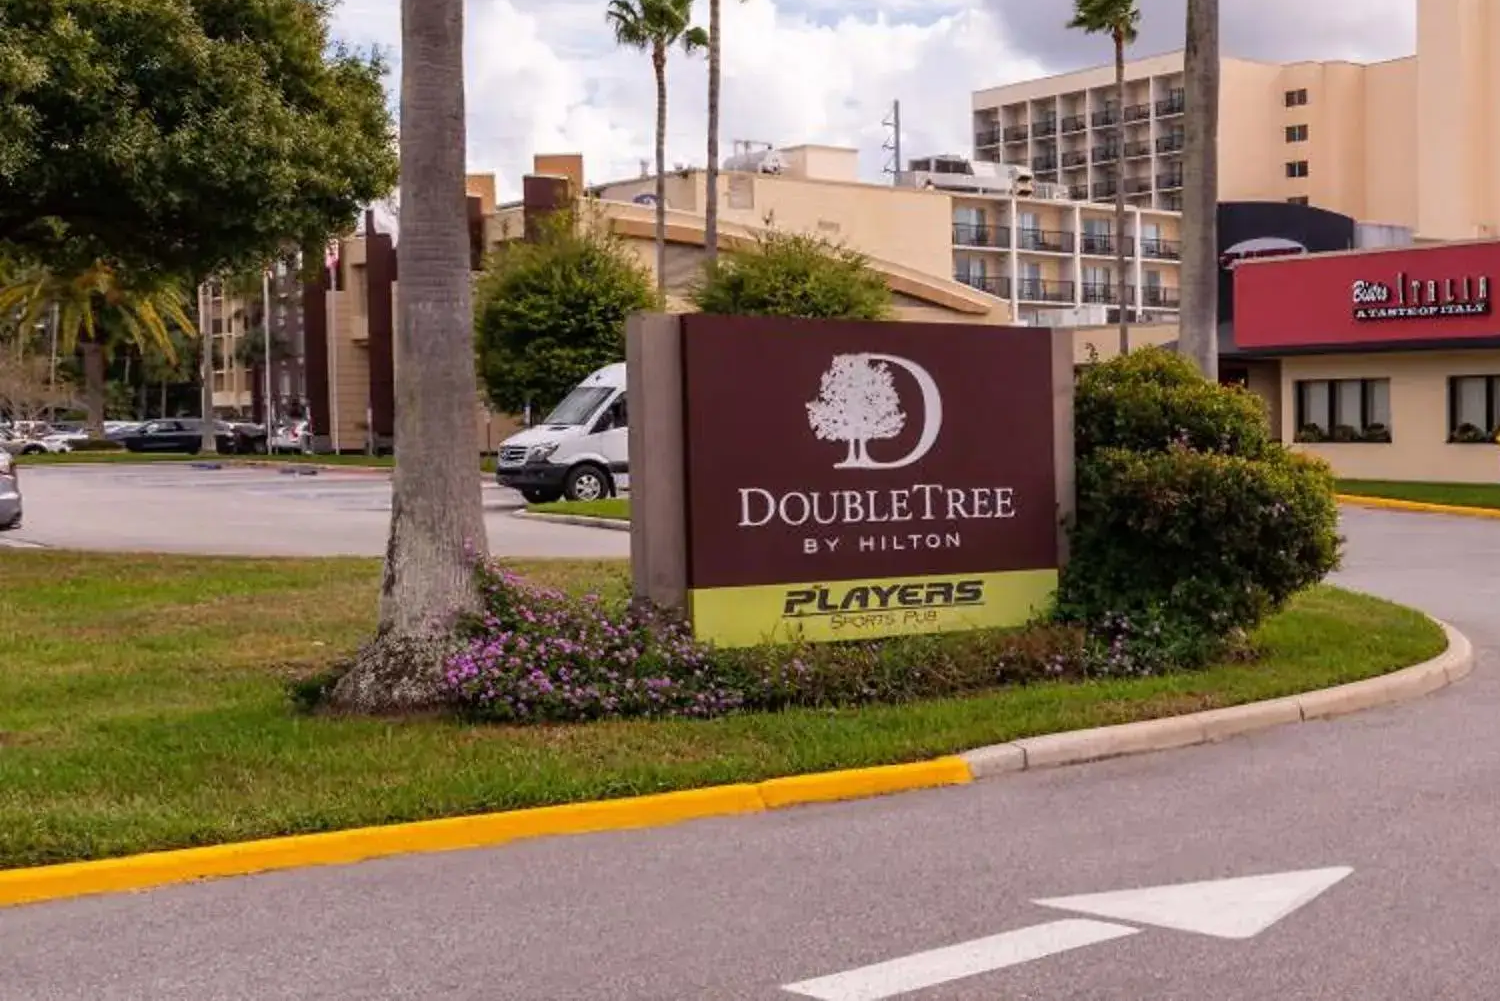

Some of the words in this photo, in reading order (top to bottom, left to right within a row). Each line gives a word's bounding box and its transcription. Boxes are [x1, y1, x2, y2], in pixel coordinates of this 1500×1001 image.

[1397, 272, 1487, 304] ITALIA
[1356, 309, 1367, 318] A
[1368, 307, 1416, 317] TASTE
[1419, 305, 1438, 316] OF
[1440, 303, 1486, 314] ITALY
[803, 537, 840, 554] BY
[859, 531, 962, 552] HILTON
[784, 579, 985, 614] PLAYERS
[831, 611, 895, 630] SPORTS
[903, 610, 939, 626] PUB
